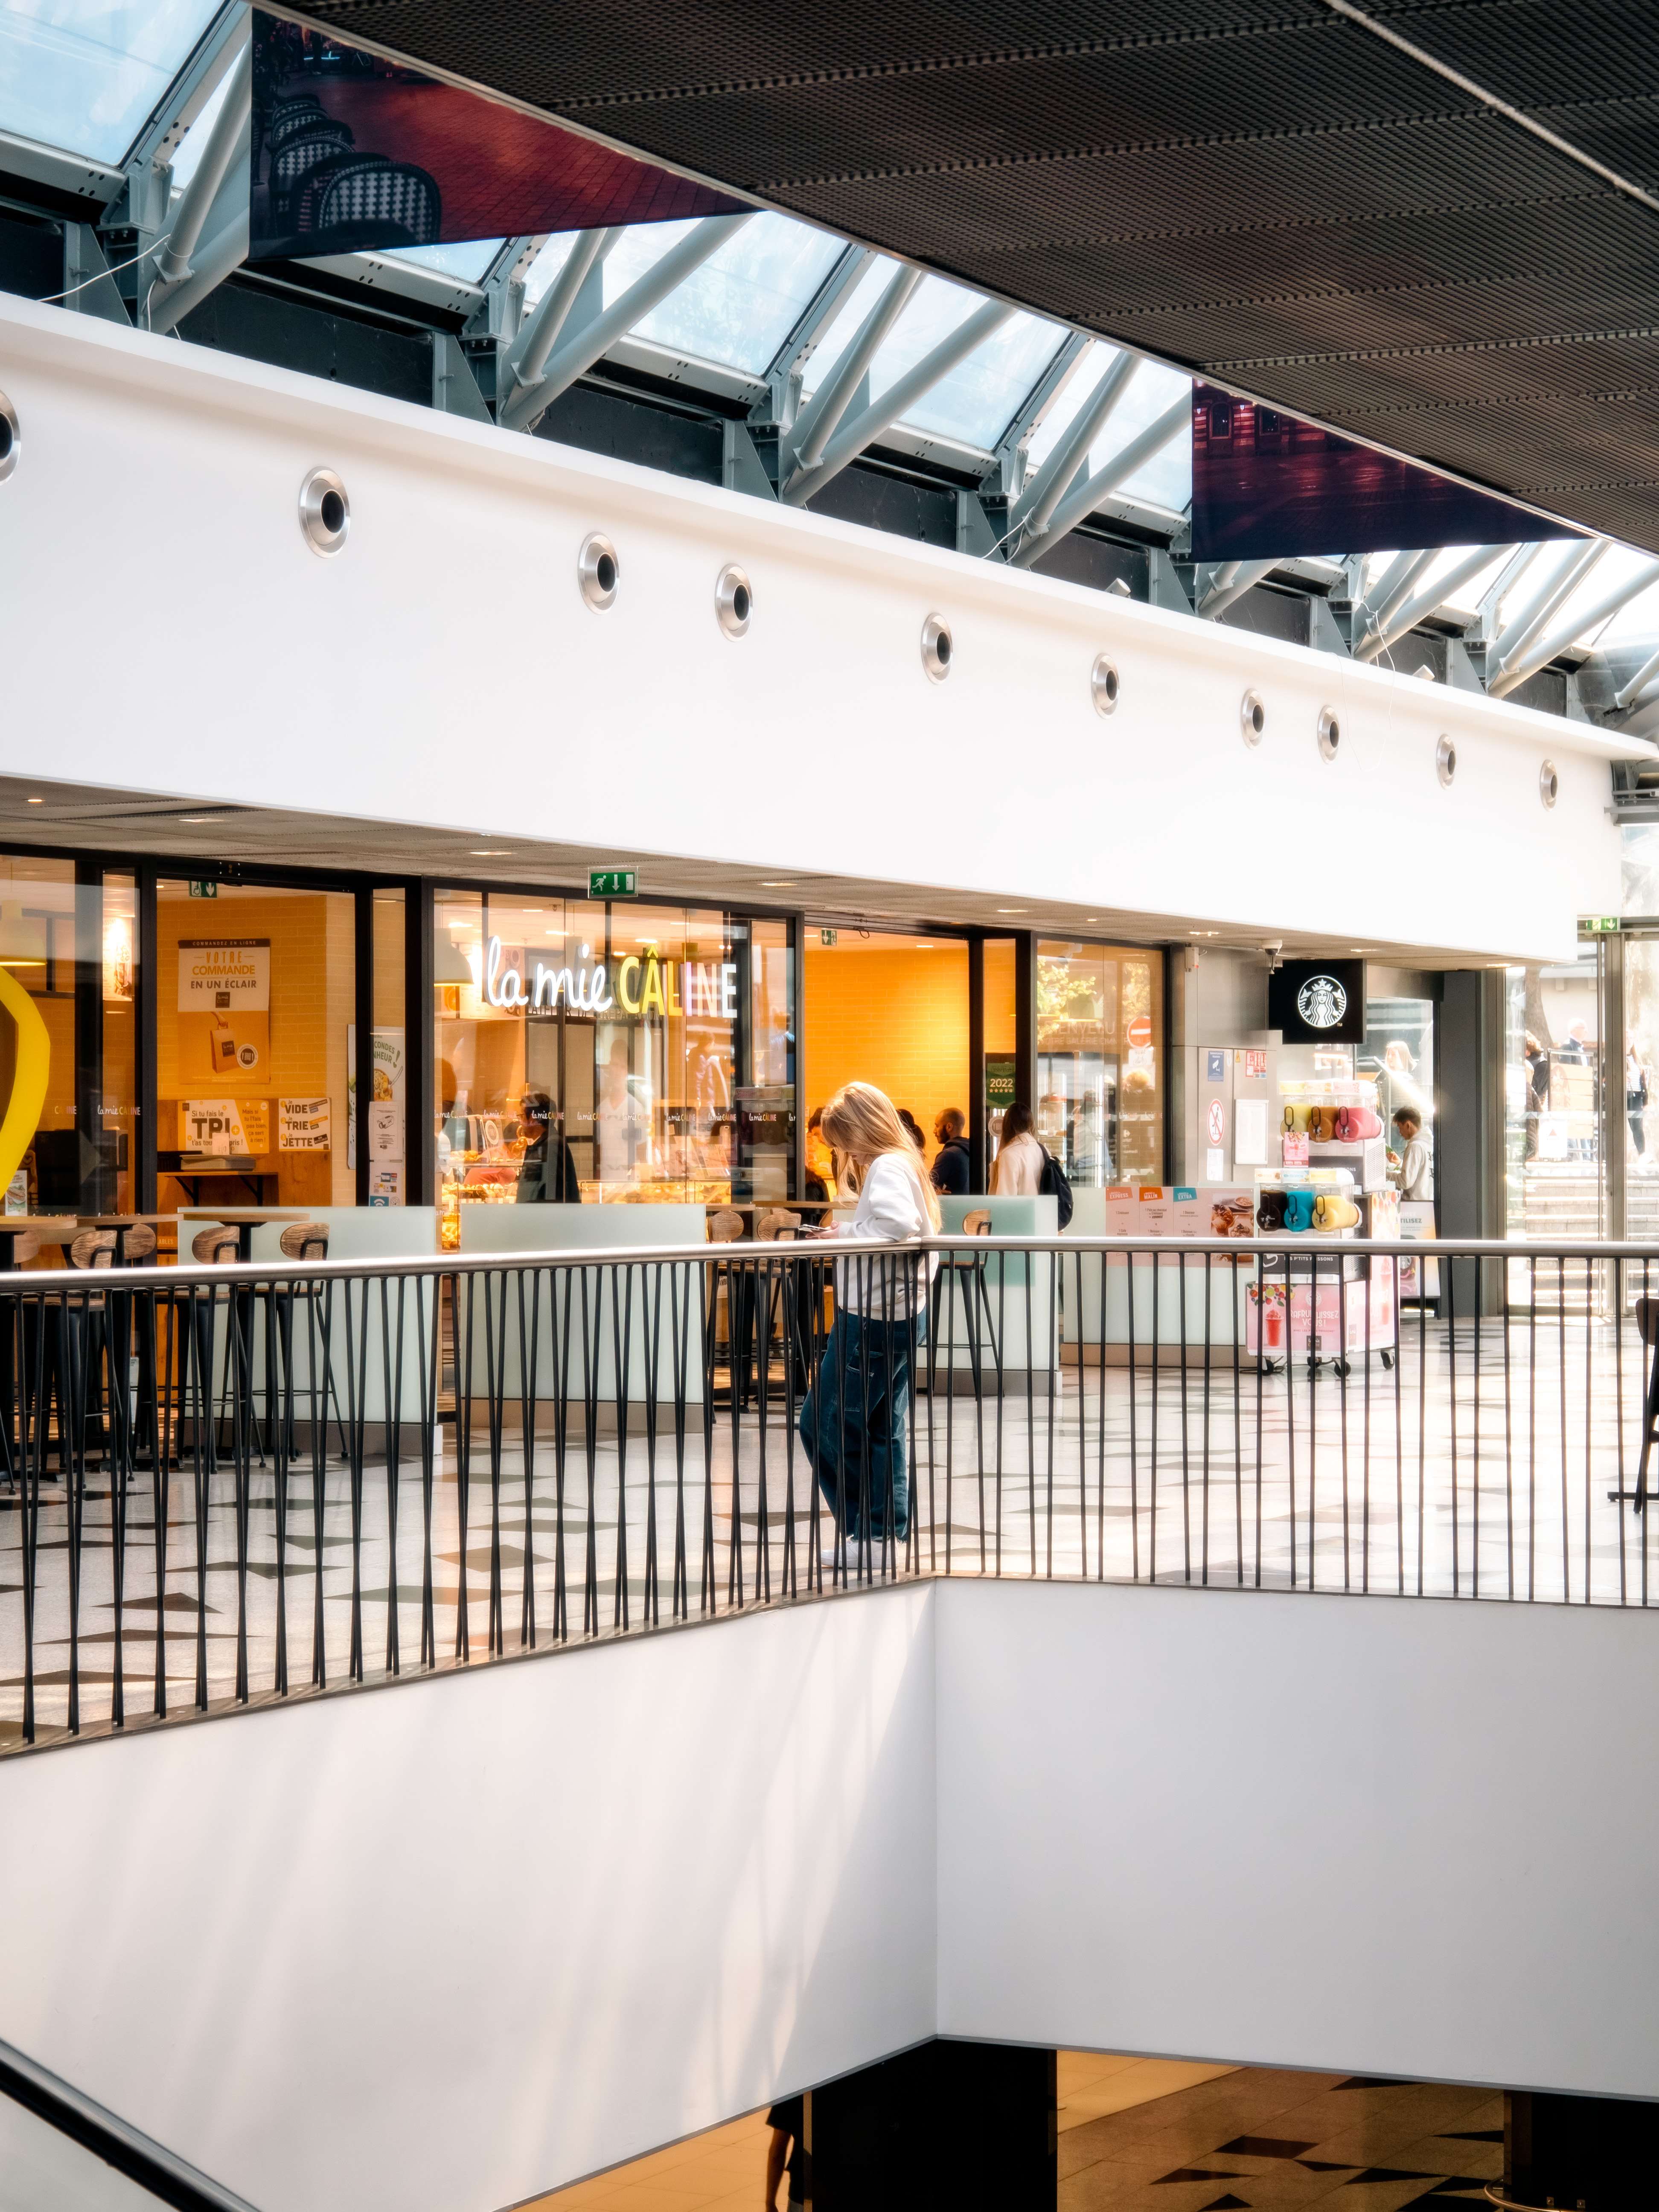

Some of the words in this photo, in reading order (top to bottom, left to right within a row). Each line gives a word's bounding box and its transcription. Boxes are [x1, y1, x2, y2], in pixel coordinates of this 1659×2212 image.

[206, 951, 242, 963] VOTRE
[192, 965, 255, 975] COMMANDE
[485, 935, 529, 1007] la
[532, 943, 613, 1012] mie
[619, 945, 737, 1018] CÂLINE
[207, 981, 221, 989] UN
[225, 978, 256, 988] ÉCLAIR
[374, 1041, 395, 1054] CONDES
[373, 1051, 392, 1064] NHEUR
[990, 1078, 1013, 1087] 2022
[285, 1104, 308, 1114] VIDE
[532, 1110, 537, 1119] la
[538, 1110, 548, 1119] mie
[577, 1111, 582, 1120] la
[582, 1112, 593, 1121] mie
[671, 1113, 681, 1121] mie
[749, 1112, 754, 1121] la
[754, 1113, 763, 1121] mie
[191, 1118, 230, 1139] TRI
[285, 1121, 309, 1130] TRIE
[282, 1138, 313, 1147] JETTE
